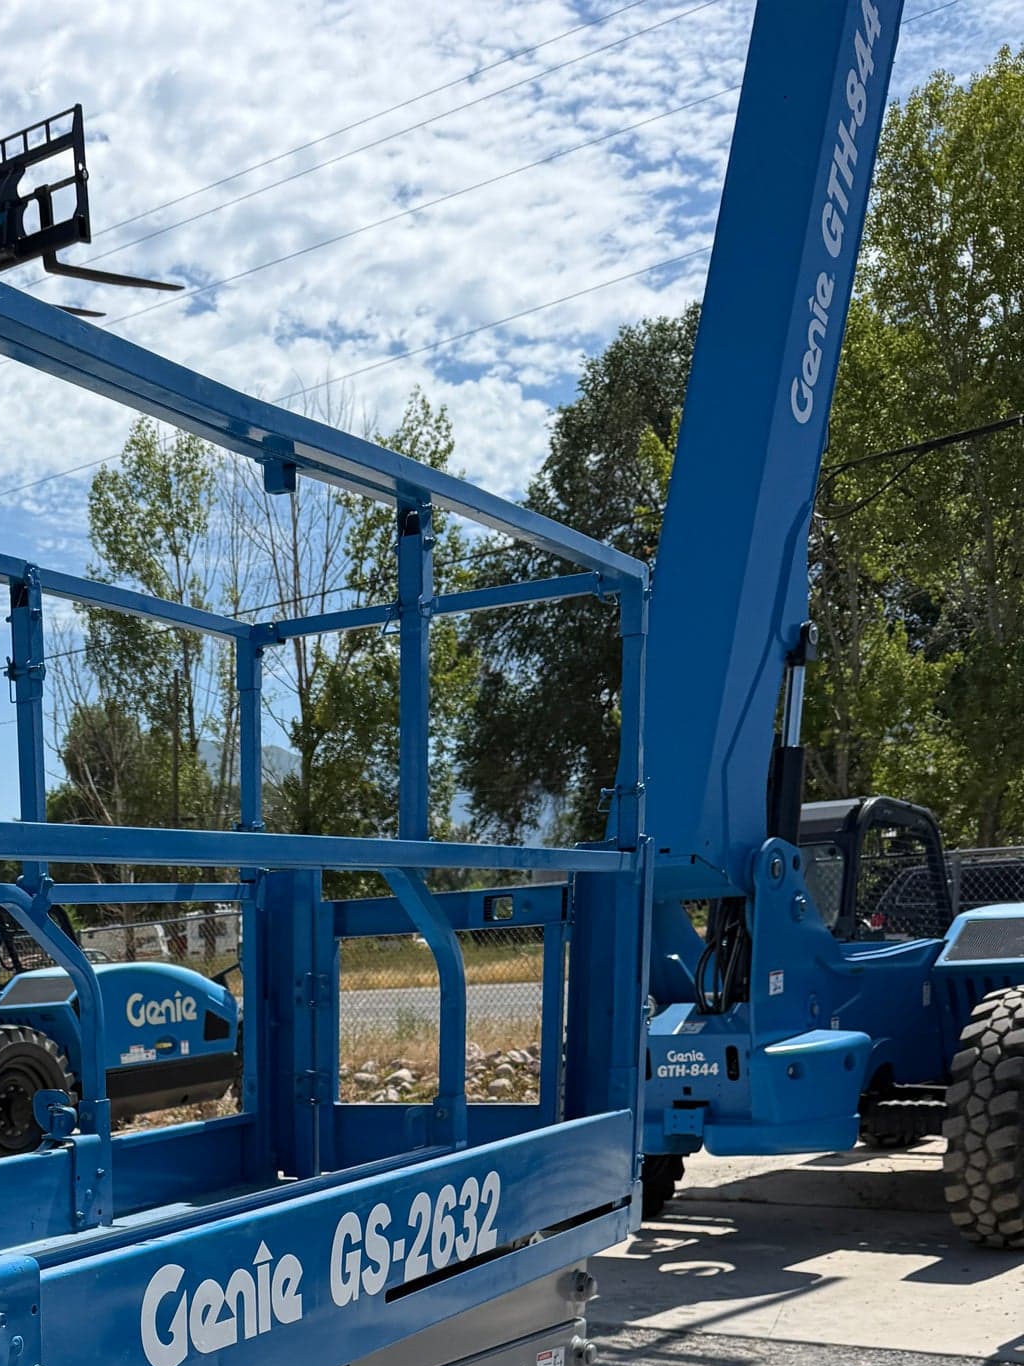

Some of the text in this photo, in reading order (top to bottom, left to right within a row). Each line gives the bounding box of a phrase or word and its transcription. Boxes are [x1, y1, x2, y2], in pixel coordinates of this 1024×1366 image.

[791, 0, 881, 424] Genie GTH-844
[127, 990, 197, 1027] Genie
[657, 1062, 719, 1077] GTH-844
[667, 1050, 705, 1062] Genie
[330, 1171, 501, 1307] GS-2632
